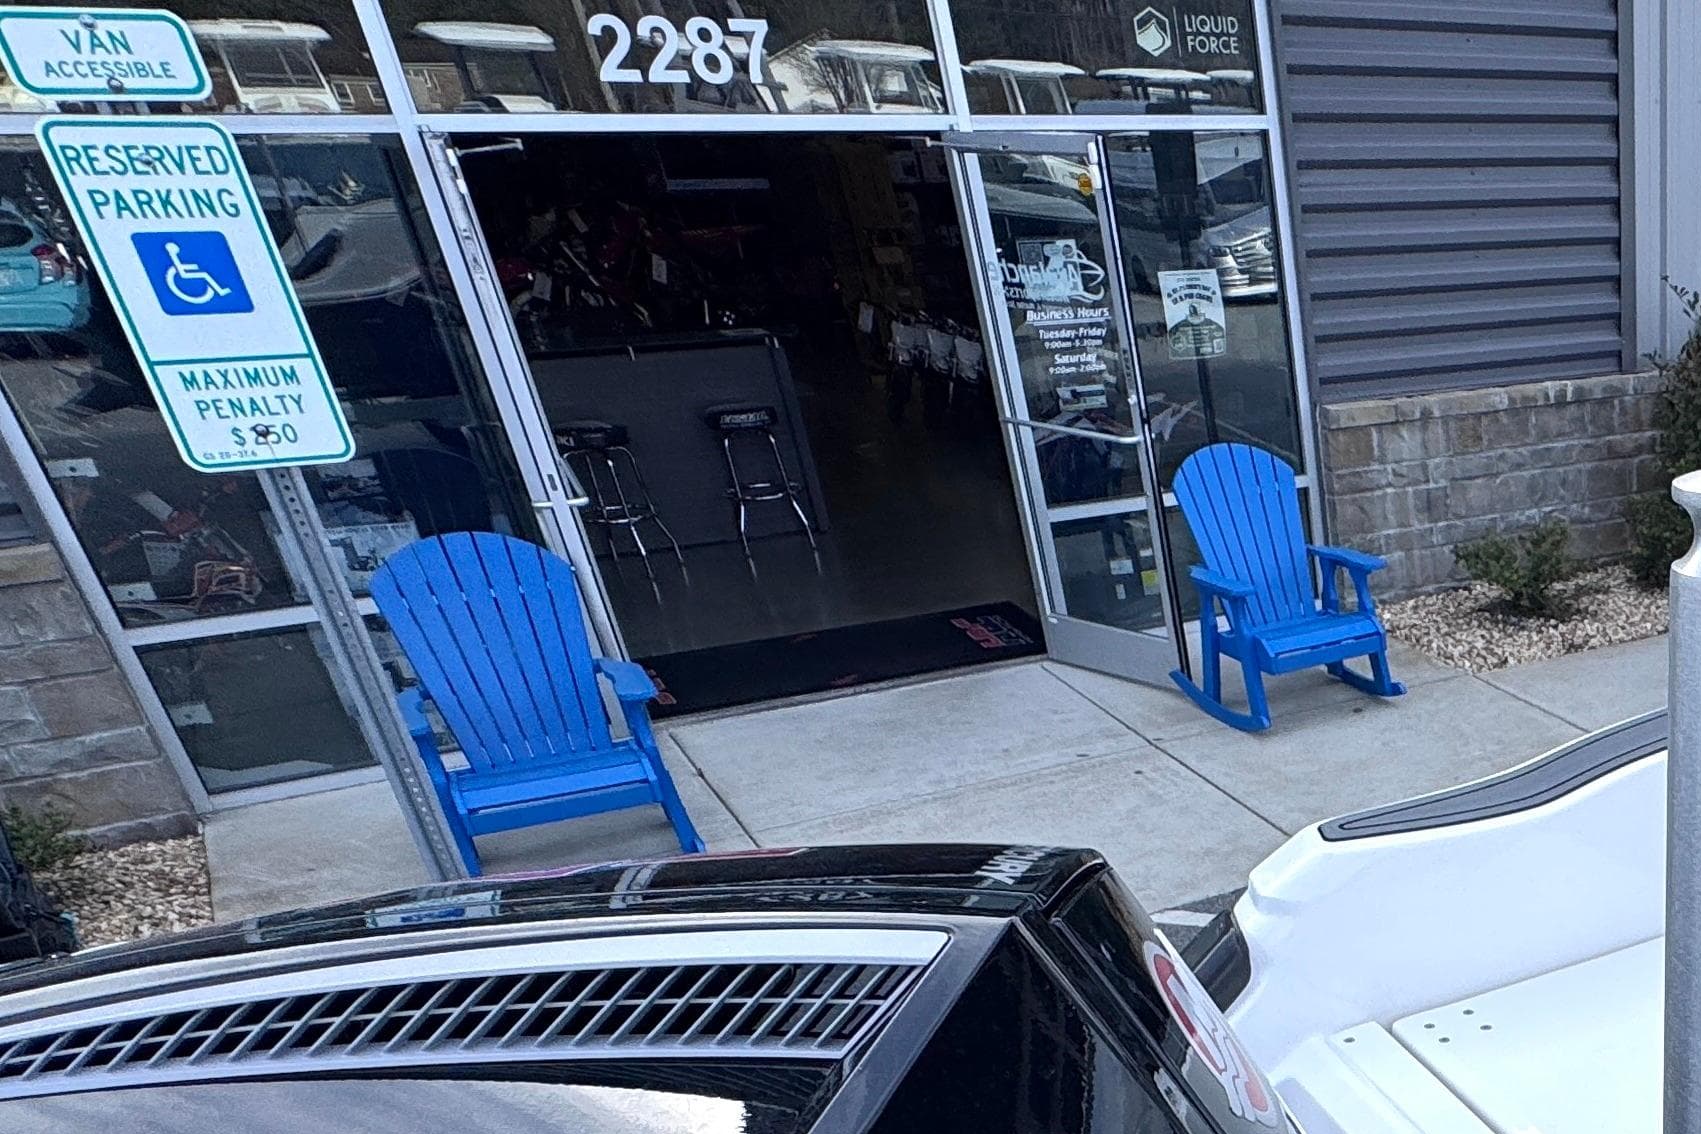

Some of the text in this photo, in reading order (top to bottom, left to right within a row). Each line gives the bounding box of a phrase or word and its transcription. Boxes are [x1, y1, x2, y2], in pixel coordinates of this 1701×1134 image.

[1183, 14, 1239, 34] LIQUID
[59, 29, 134, 56] VAN
[587, 13, 769, 85] 2287
[1186, 35, 1240, 55] FORCE
[44, 60, 177, 80] ACCESSIBLE
[58, 144, 230, 176] RESERVED
[87, 188, 241, 221] PARKING
[1027, 307, 1110, 321] Business Hours
[1054, 352, 1097, 364] Saturday
[178, 365, 300, 392] MAXIMUM
[195, 394, 305, 421] PENALTY
